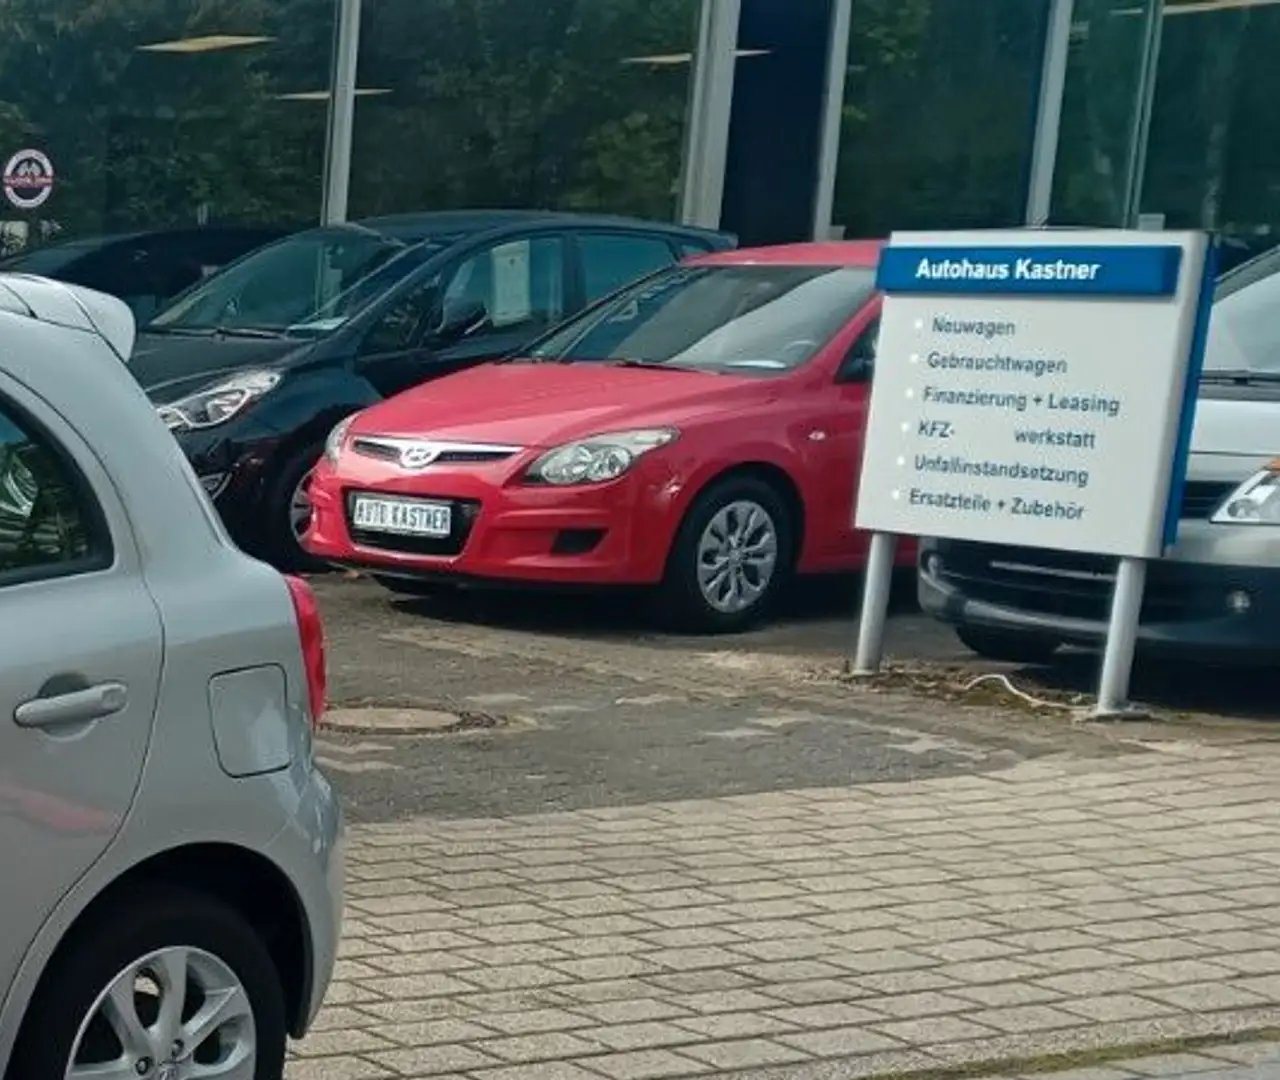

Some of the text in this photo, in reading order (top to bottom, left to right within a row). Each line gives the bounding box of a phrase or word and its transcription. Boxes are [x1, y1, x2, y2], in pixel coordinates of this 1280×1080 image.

[915, 257, 1101, 281] Autohaus Kastner
[932, 317, 1016, 339] Neuwagen
[927, 351, 1067, 377] Gebrauchtwagen
[923, 386, 1027, 412] Finanzierung
[1048, 393, 1120, 417] Leasing
[918, 419, 1096, 449] KFZ- werkstatt
[915, 454, 1090, 488] Unfallinstandsetzung
[909, 487, 992, 512] Ersatzteile
[1011, 497, 1085, 521] Zubehör
